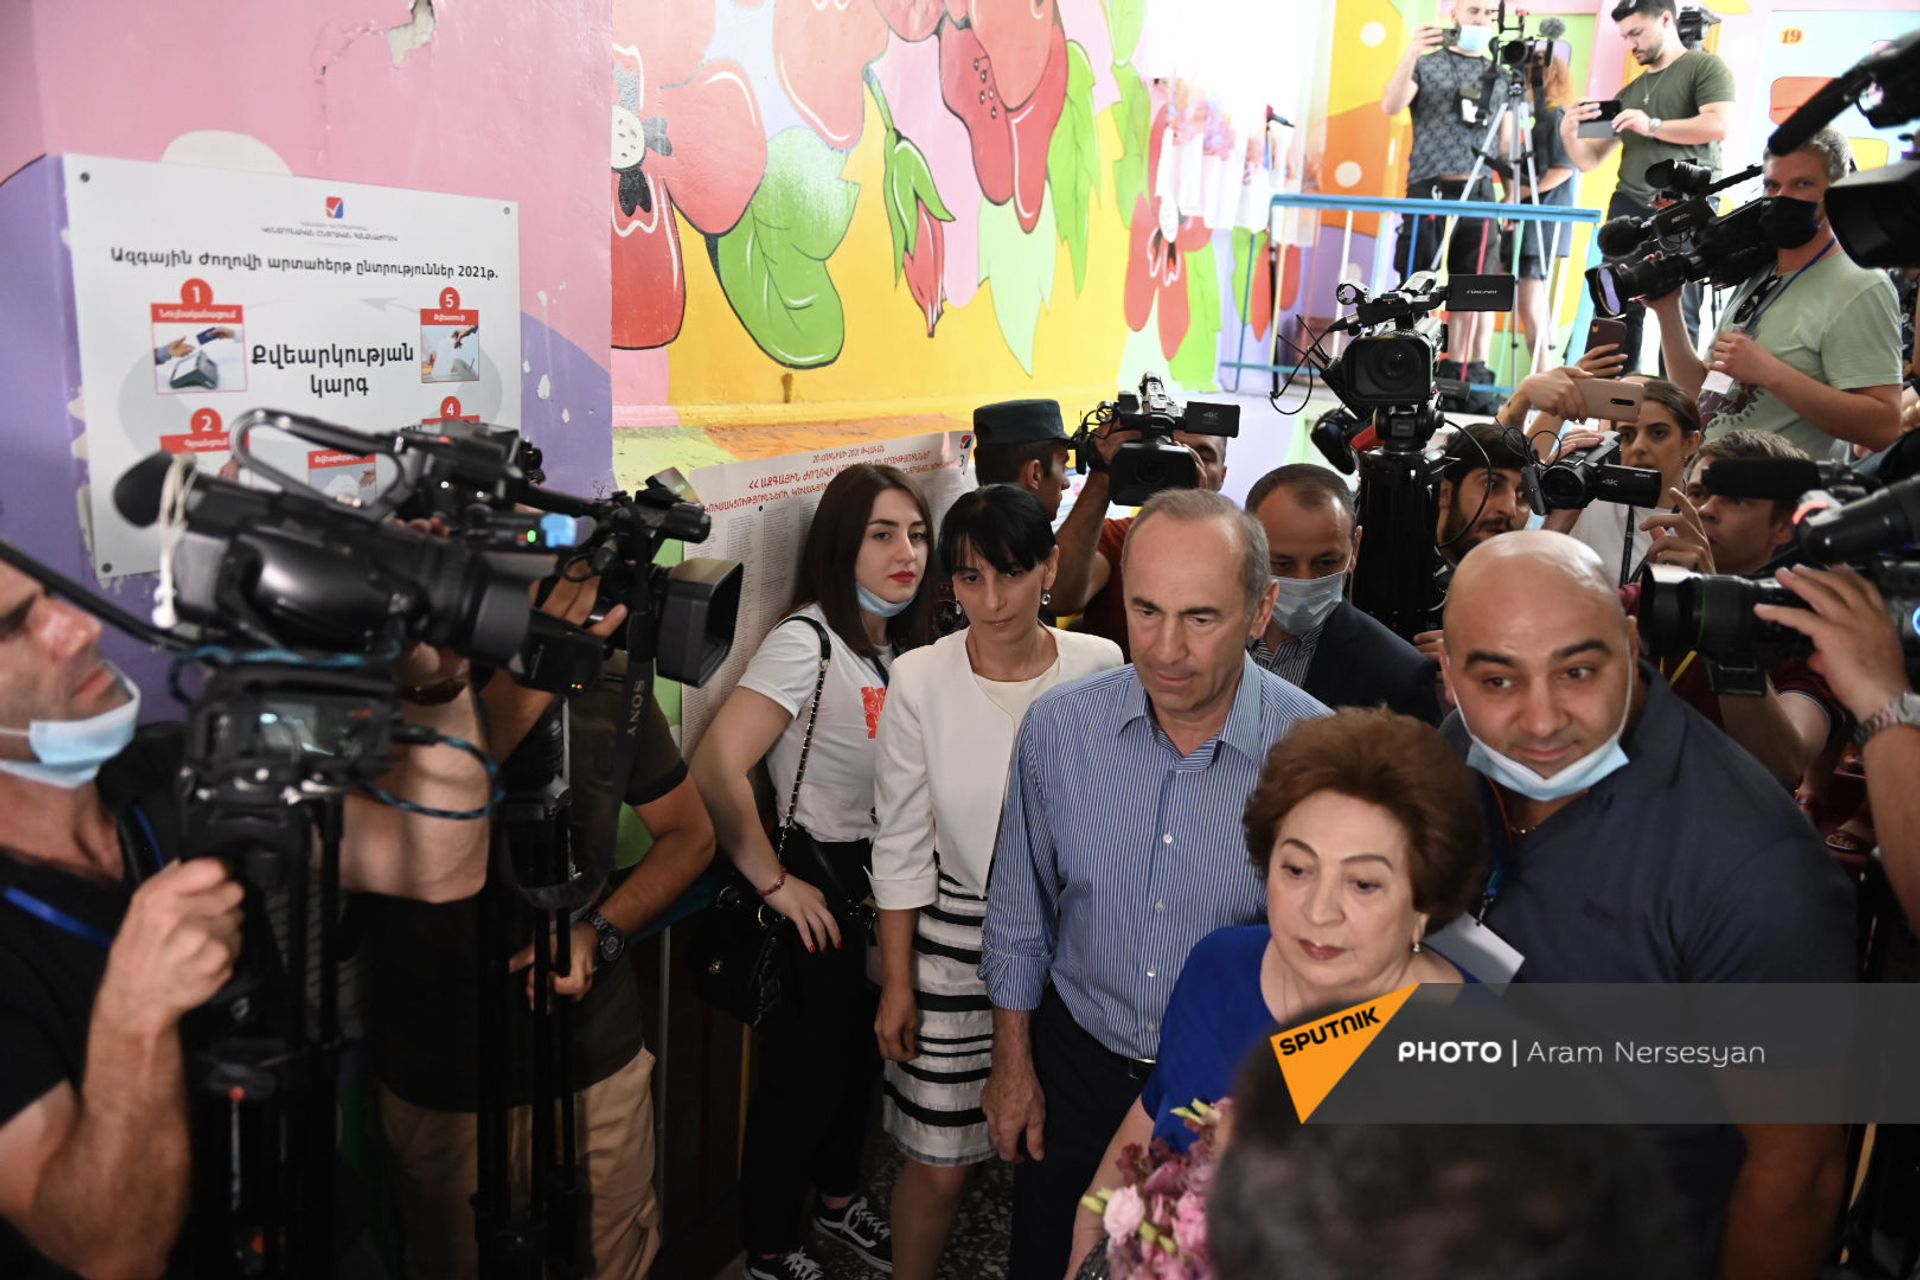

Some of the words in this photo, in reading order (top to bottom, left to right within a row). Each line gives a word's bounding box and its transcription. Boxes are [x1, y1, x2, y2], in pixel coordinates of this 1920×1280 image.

[1782, 28, 1802, 44] 19
[110, 247, 192, 268] Ազգային
[268, 257, 352, 275] արտահերթ
[356, 259, 454, 279] ընտրություններ
[457, 265, 499, 280] 2021թ.
[192, 286, 201, 304] 1
[445, 294, 454, 308] 5
[251, 342, 414, 369] Քվեարկության
[310, 374, 369, 398] կարգ
[446, 402, 455, 416] 4
[201, 415, 213, 432] 2
[627, 680, 645, 736] SONY
